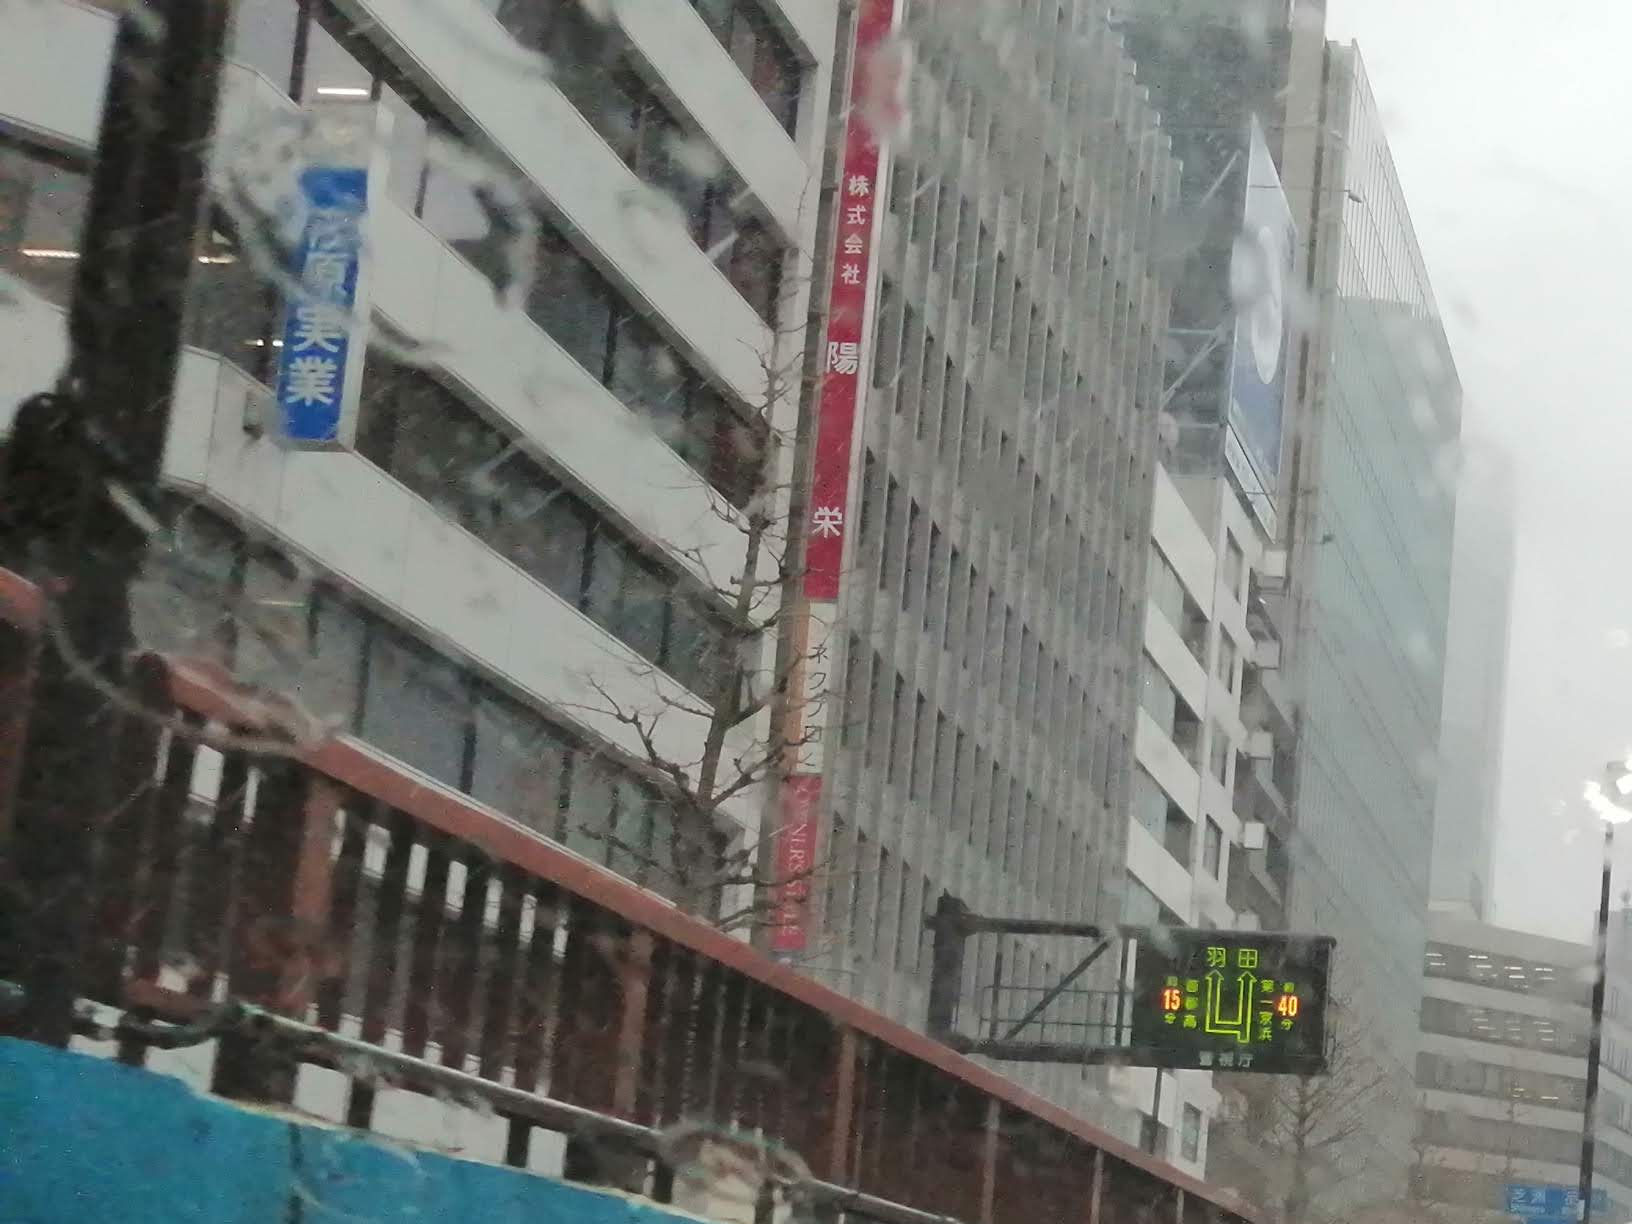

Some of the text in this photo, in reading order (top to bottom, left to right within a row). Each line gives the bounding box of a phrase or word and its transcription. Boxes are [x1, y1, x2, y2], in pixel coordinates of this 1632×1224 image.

[841, 175, 870, 285] 株式会社
[286, 208, 360, 406] 原実業
[1207, 946, 1258, 968] 羽田
[1163, 989, 1180, 1010] 15
[1278, 996, 1298, 1016] 40
